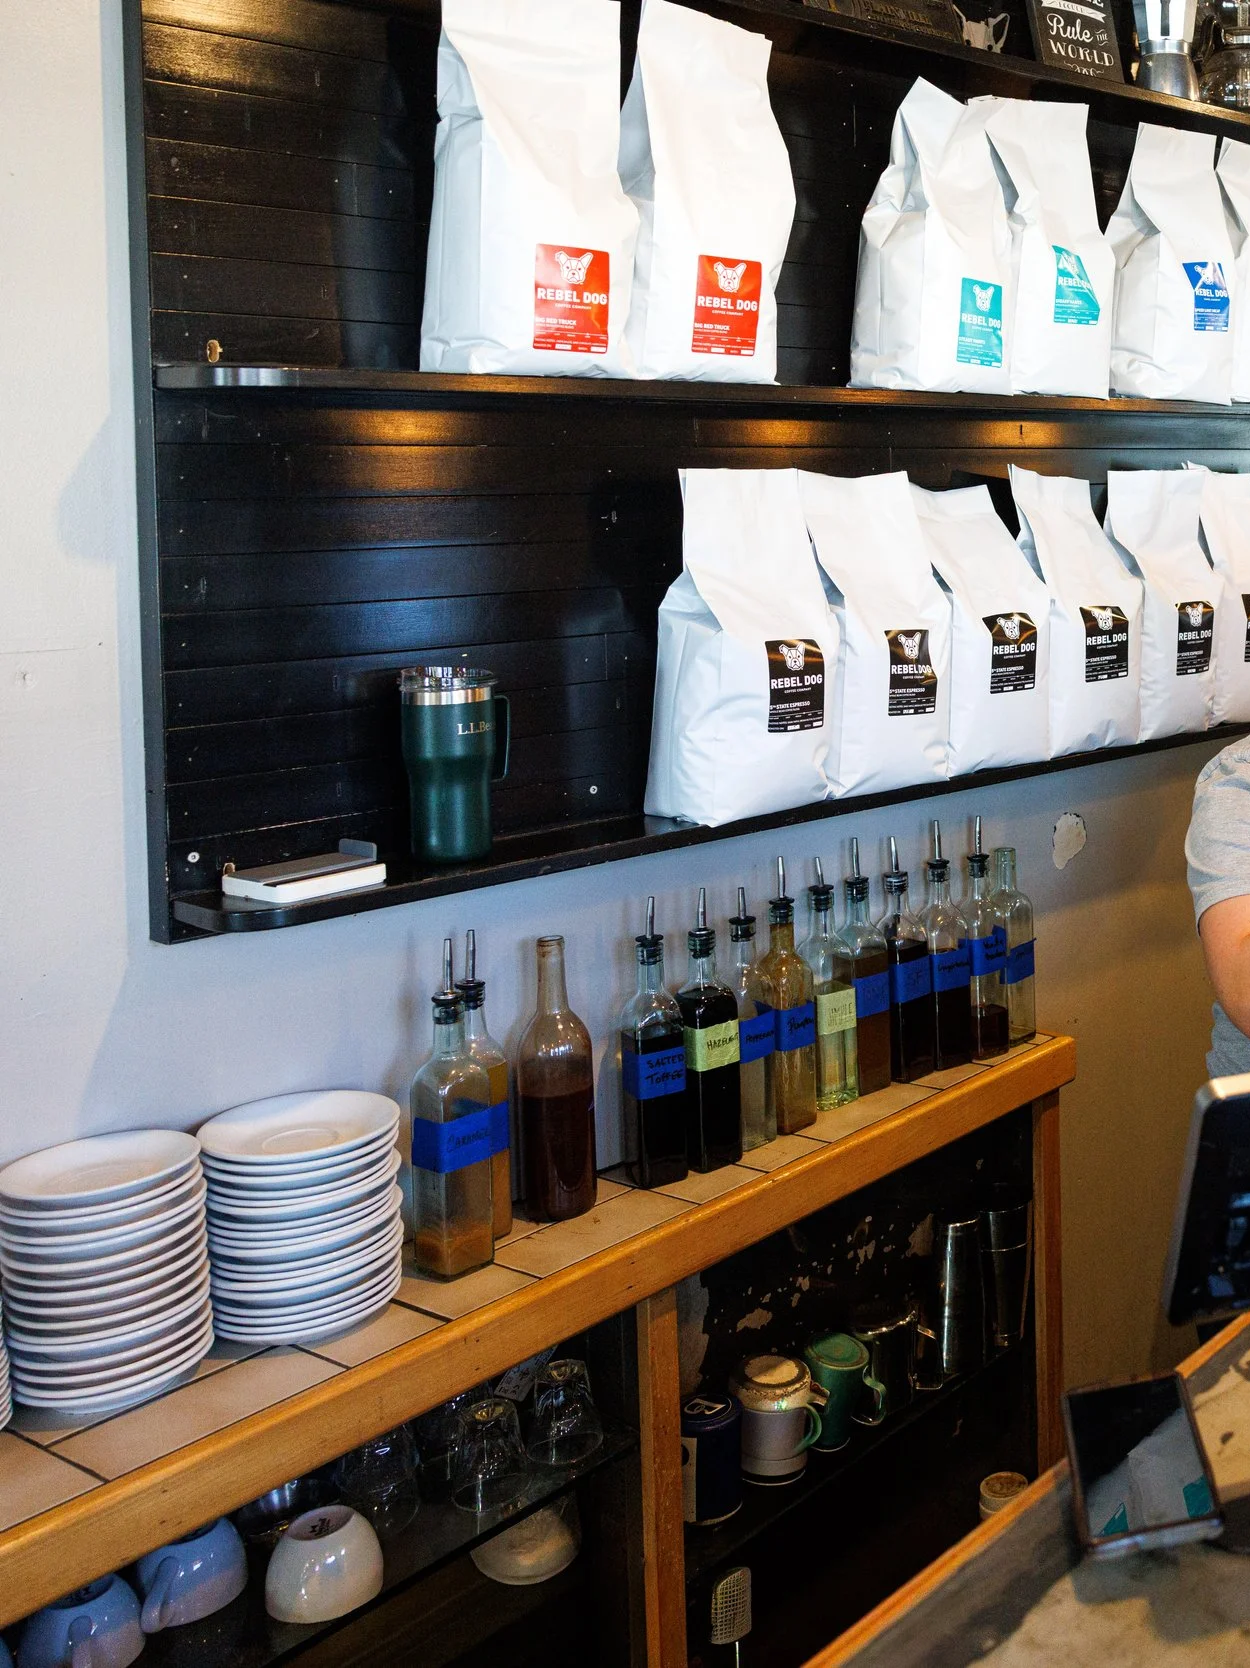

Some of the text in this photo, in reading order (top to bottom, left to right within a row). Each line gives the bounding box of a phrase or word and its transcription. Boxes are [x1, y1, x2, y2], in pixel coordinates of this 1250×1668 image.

[1047, 13, 1093, 42] Rule
[1049, 39, 1114, 66] WORLD
[1058, 276, 1081, 287] REBEL
[537, 288, 608, 305] REBEL DOG
[1195, 288, 1228, 297] REBEL DOG
[697, 296, 758, 311] REBEL DOG
[962, 313, 1000, 328] REBEL DOG
[1087, 632, 1127, 646] REBEL DOG
[1179, 629, 1211, 641] REBEL DOG
[993, 642, 1035, 655] REBEL DOG
[891, 664, 932, 674] REBEL DOG
[771, 674, 822, 689] REBEL DOG
[647, 1053, 685, 1069] SALTED
